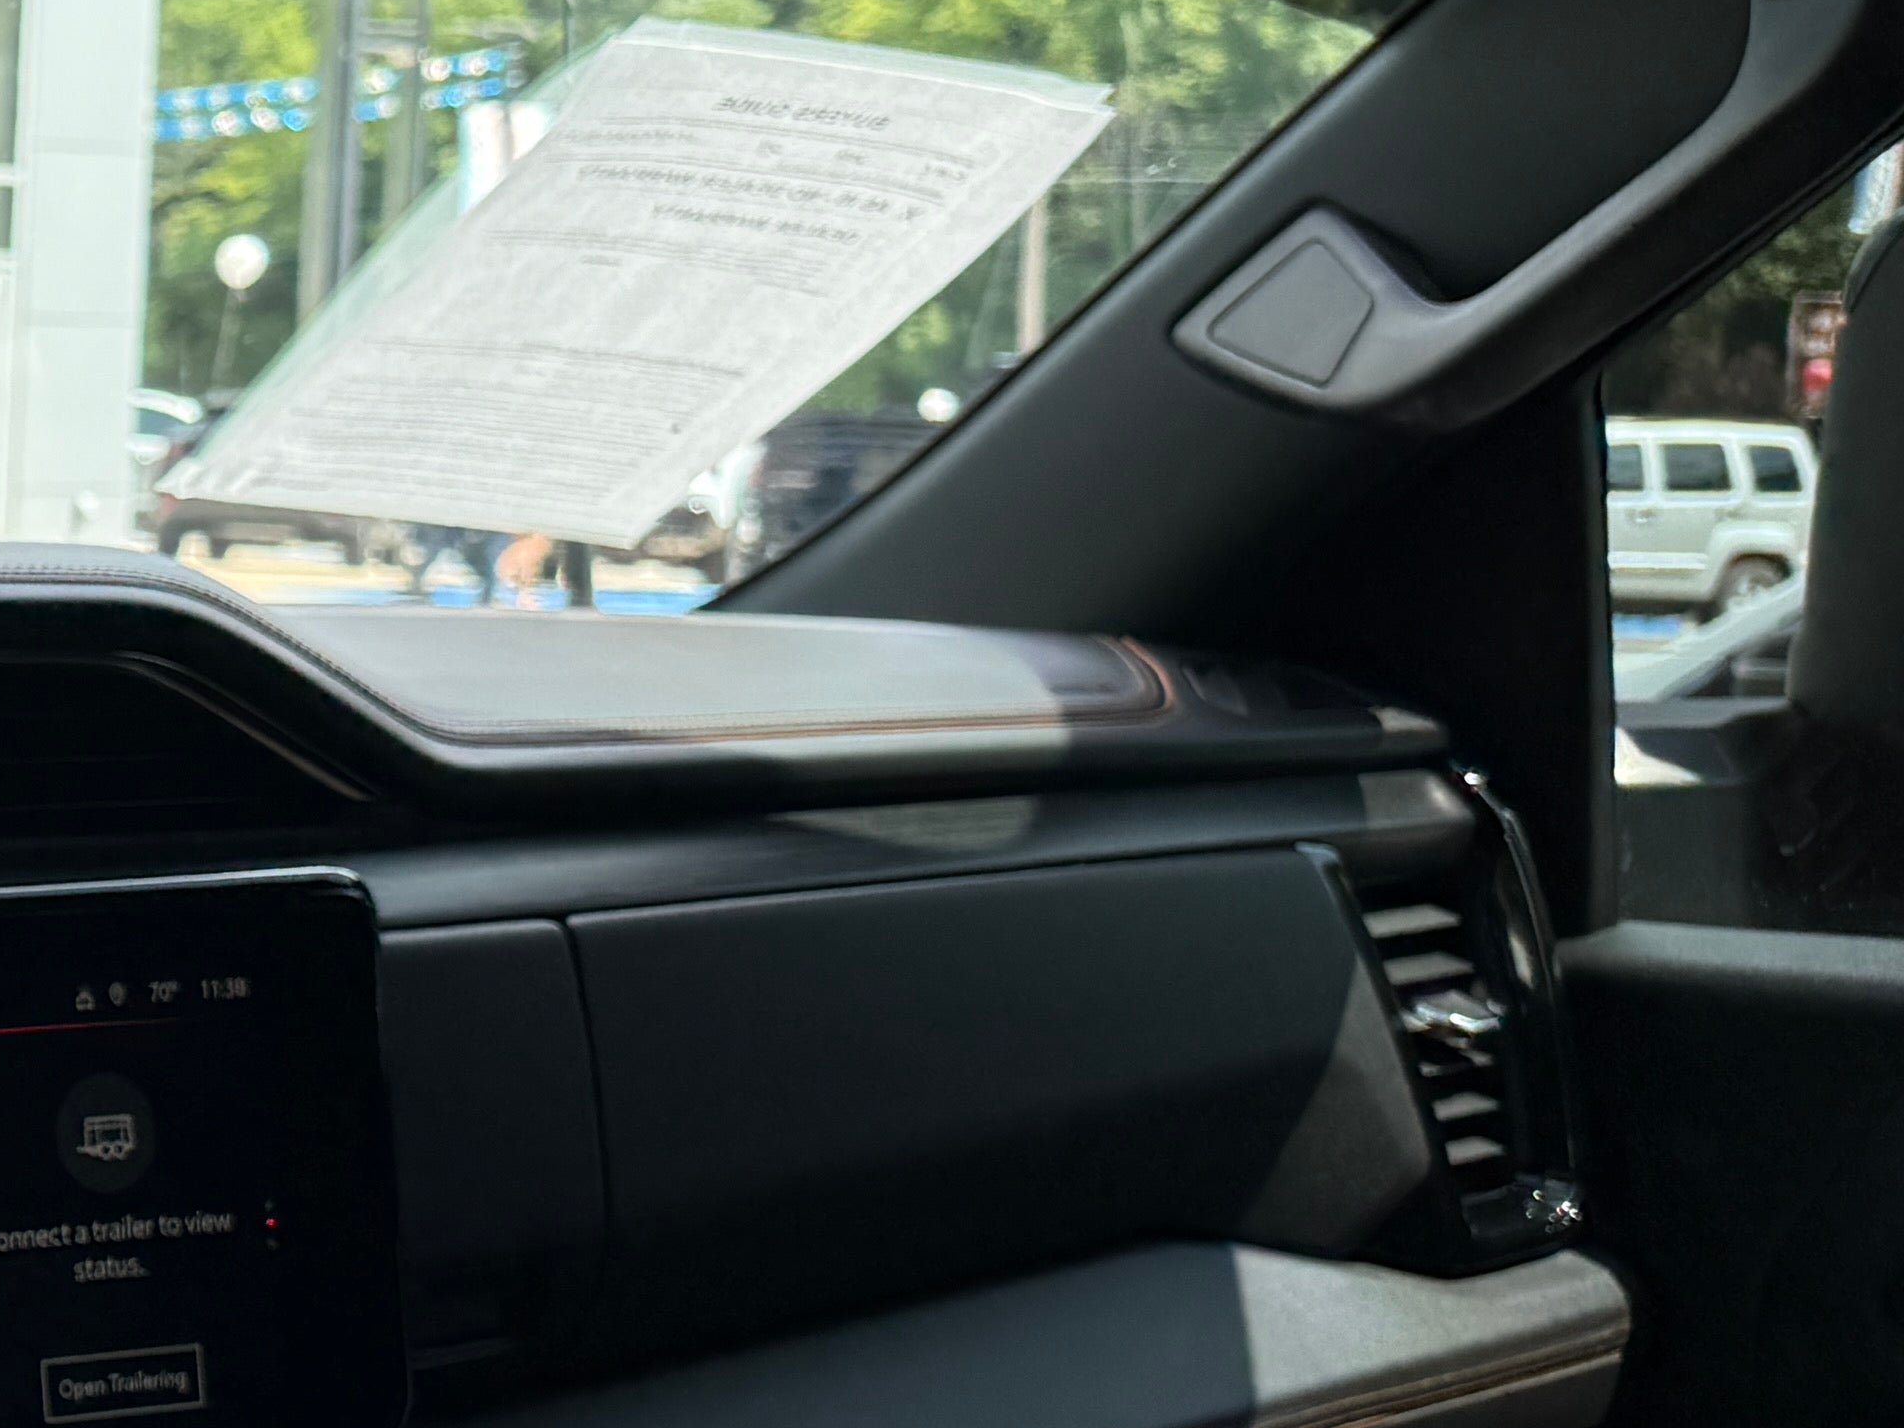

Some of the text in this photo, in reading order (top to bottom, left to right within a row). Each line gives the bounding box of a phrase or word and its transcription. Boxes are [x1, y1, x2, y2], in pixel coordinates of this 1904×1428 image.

[74, 1224, 91, 1246] a
[91, 1213, 156, 1244] trailer
[158, 1213, 184, 1239] to
[184, 1209, 238, 1236] view
[72, 1254, 151, 1284] status.
[58, 1369, 191, 1402] Open Trailering
